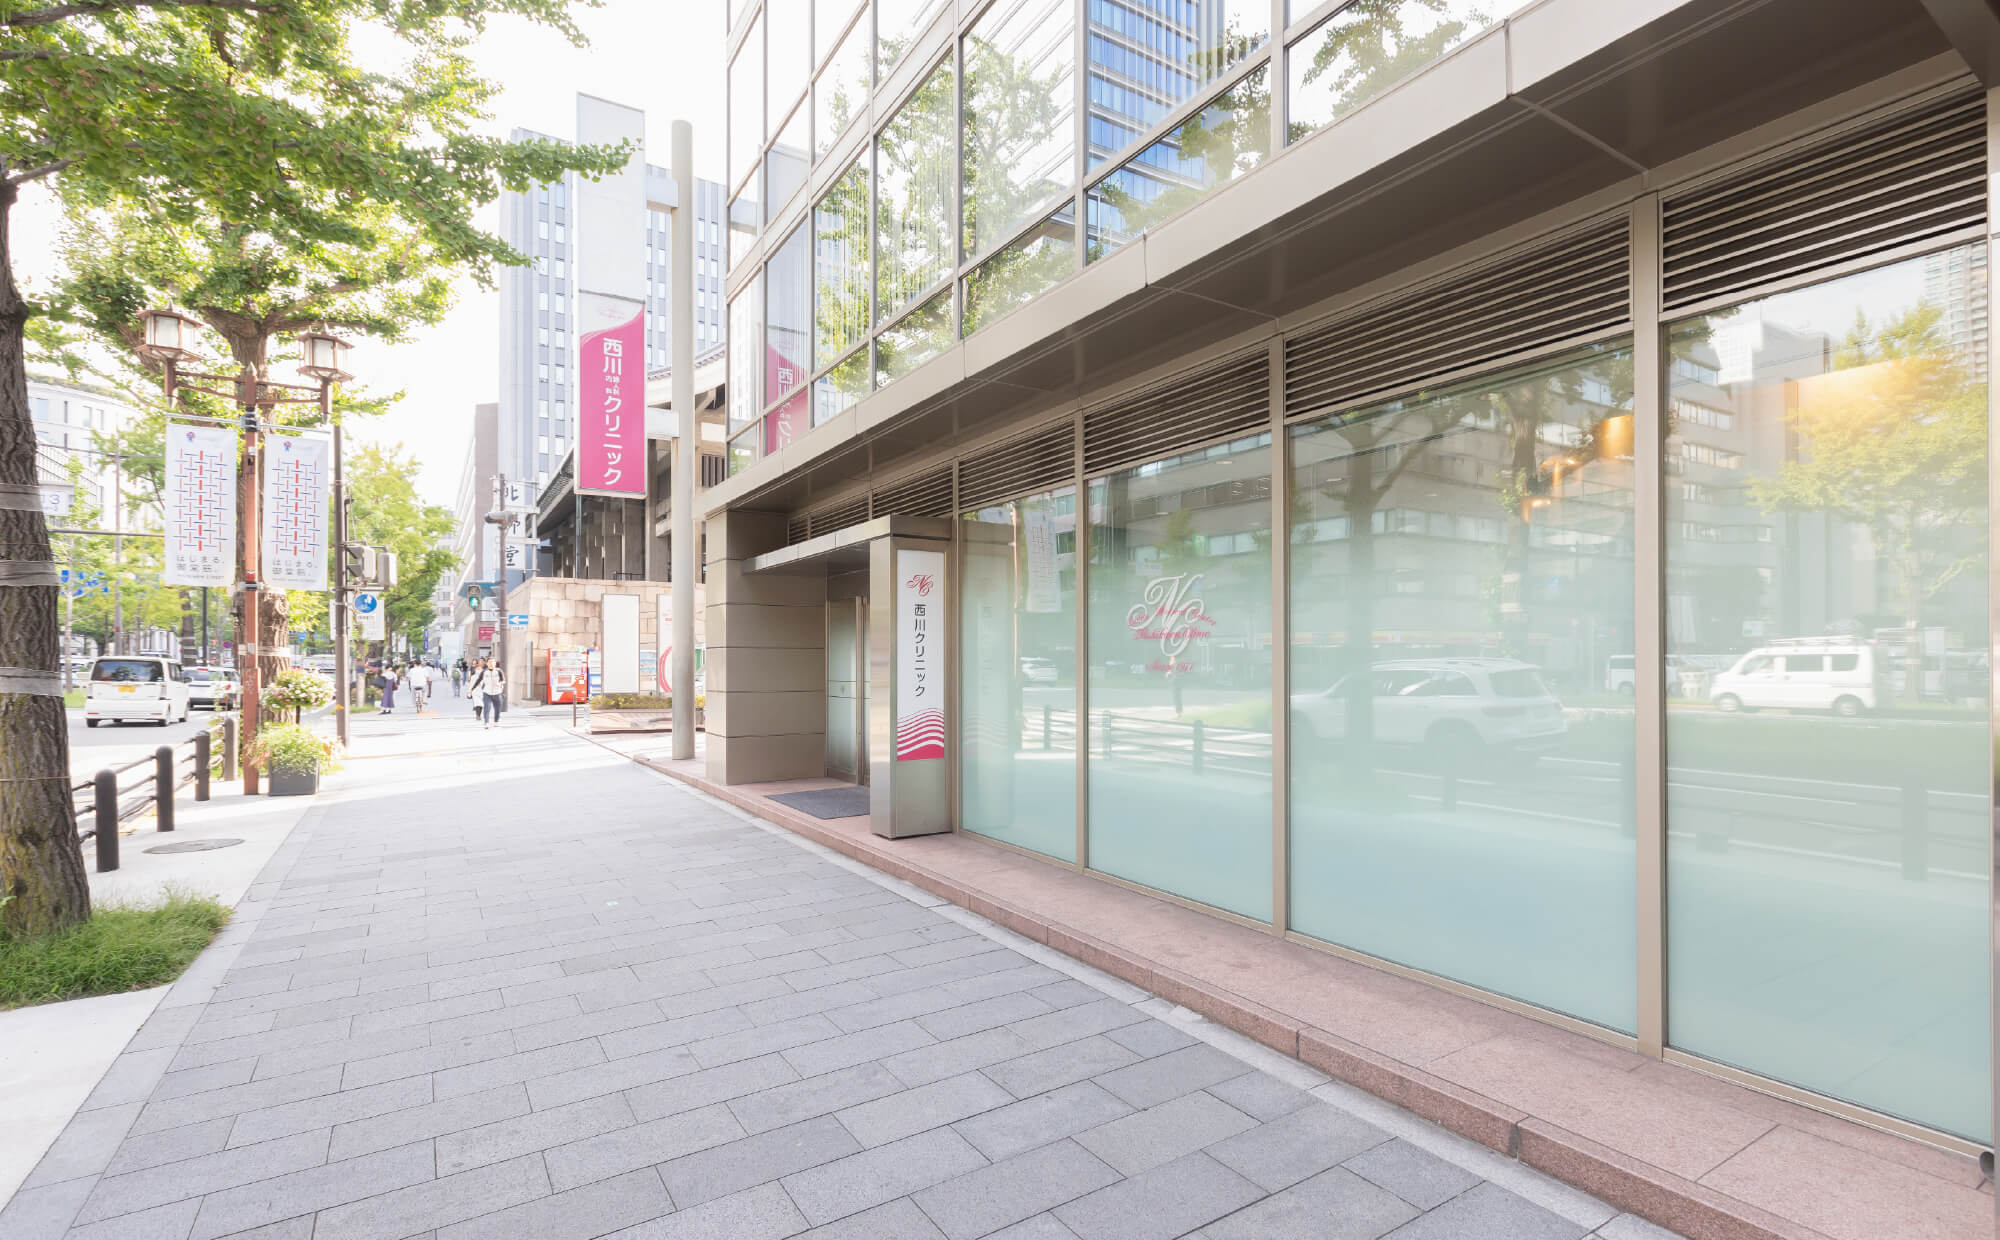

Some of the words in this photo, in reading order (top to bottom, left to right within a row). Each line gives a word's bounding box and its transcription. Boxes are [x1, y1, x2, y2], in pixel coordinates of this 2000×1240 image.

[603, 395, 623, 485] クリニック
[914, 603, 926, 697] 西川クリニック
